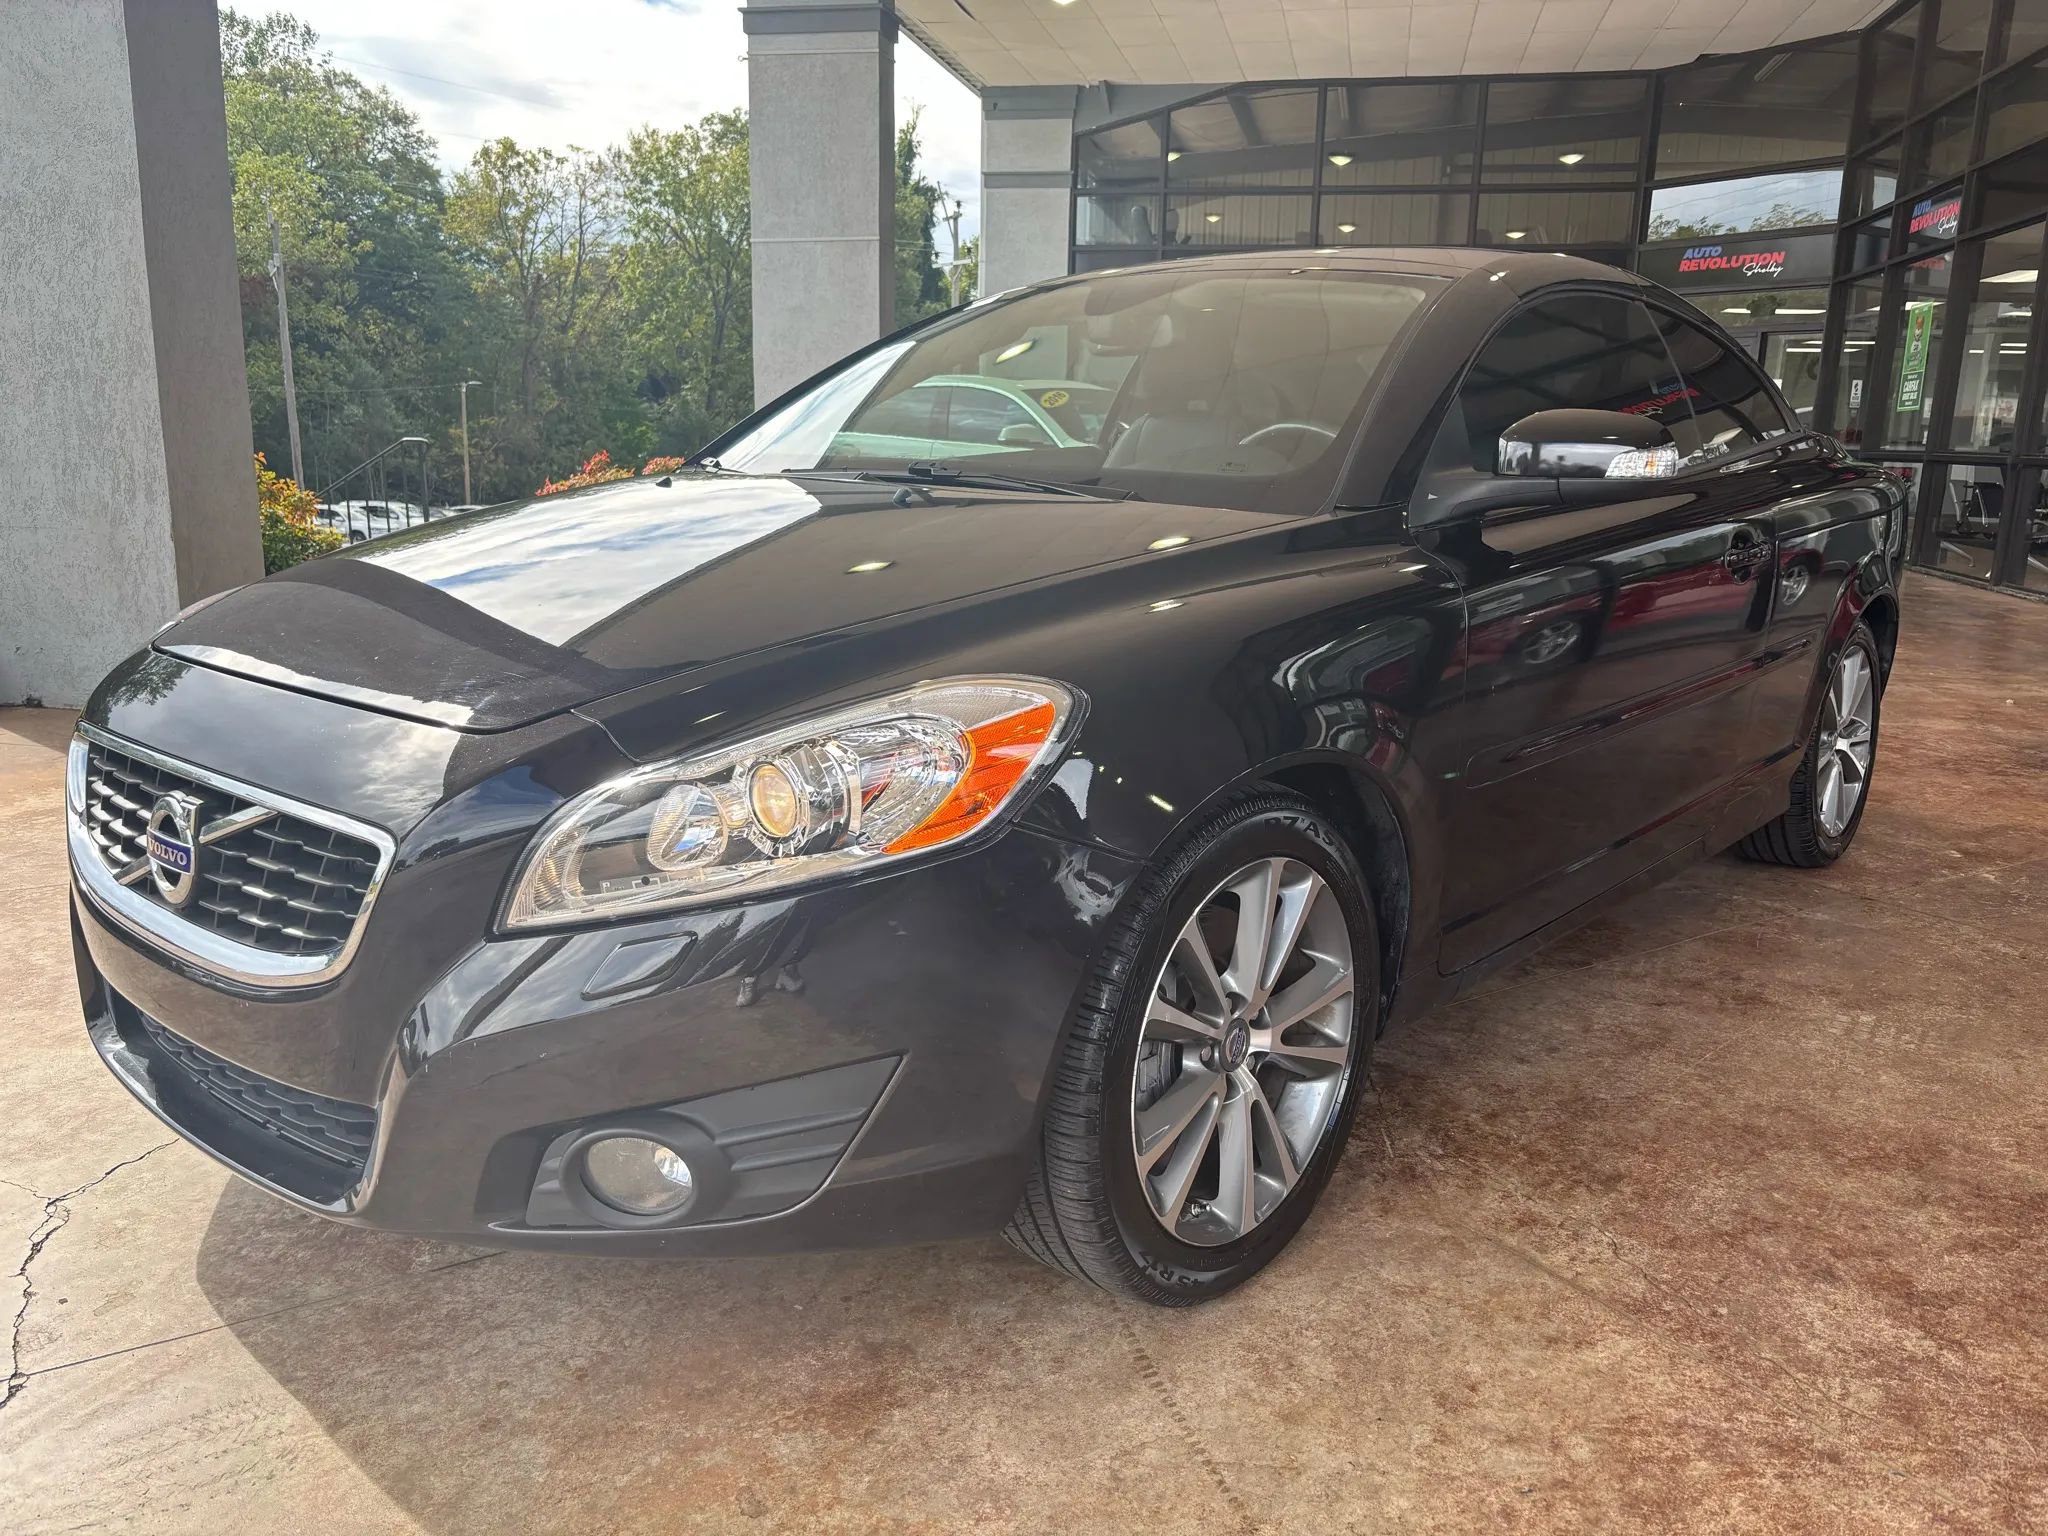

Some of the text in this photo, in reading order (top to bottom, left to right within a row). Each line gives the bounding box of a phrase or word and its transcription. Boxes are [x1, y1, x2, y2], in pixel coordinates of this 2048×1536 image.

[1909, 200, 1962, 234] REVOLUTION
[1912, 200, 1932, 218] AUTO
[1679, 251, 1786, 272] REVOLUTION
[1683, 245, 1722, 259] AUTO
[1742, 260, 1784, 277] Shelby
[147, 836, 188, 866] VOLVO
